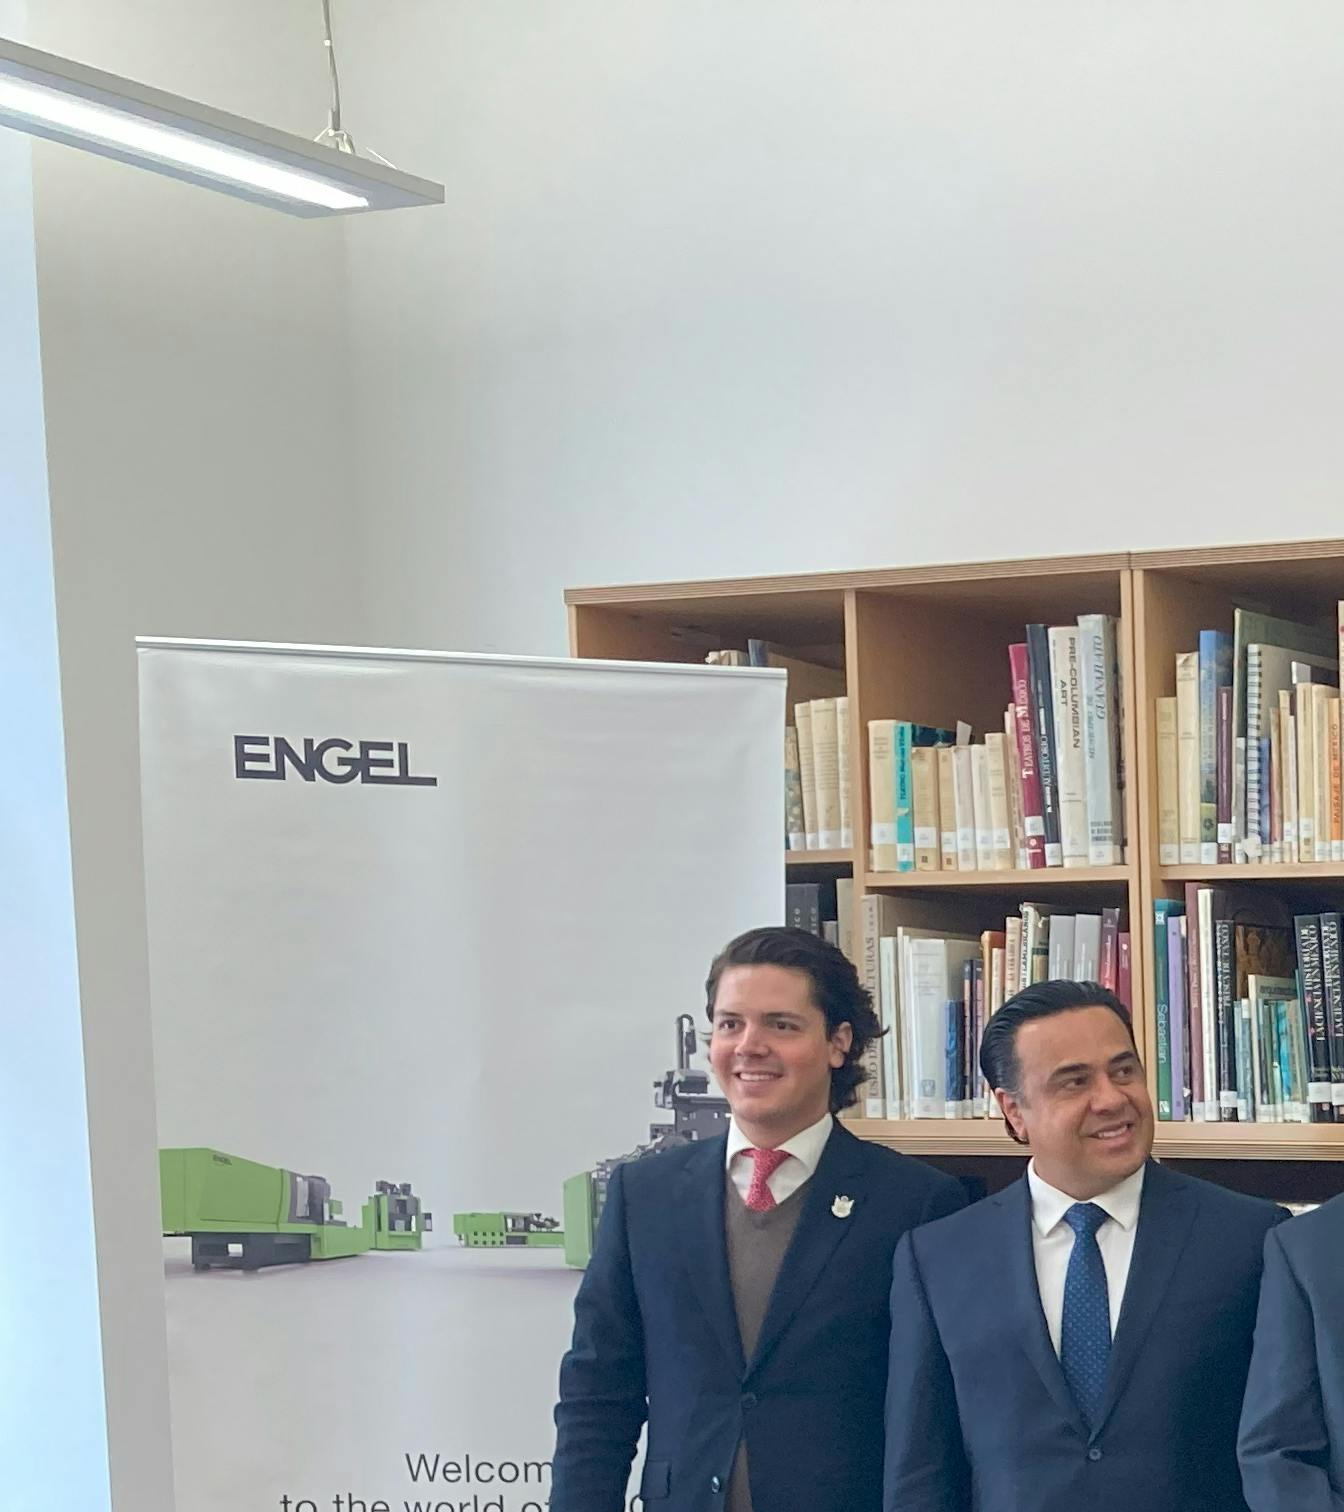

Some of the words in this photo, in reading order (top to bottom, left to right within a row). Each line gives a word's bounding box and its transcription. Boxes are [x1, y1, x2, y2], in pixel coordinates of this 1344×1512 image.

[1060, 680, 1068, 707] ART
[1068, 637, 1081, 748] PRE-COLUMBIAN
[1092, 635, 1106, 720] GUANAJUATO
[1020, 719, 1031, 732] DE
[234, 735, 437, 786] ENGEL
[1020, 734, 1034, 779] TEATROS
[1332, 764, 1339, 777] DE
[405, 1453, 552, 1484] Welcom
